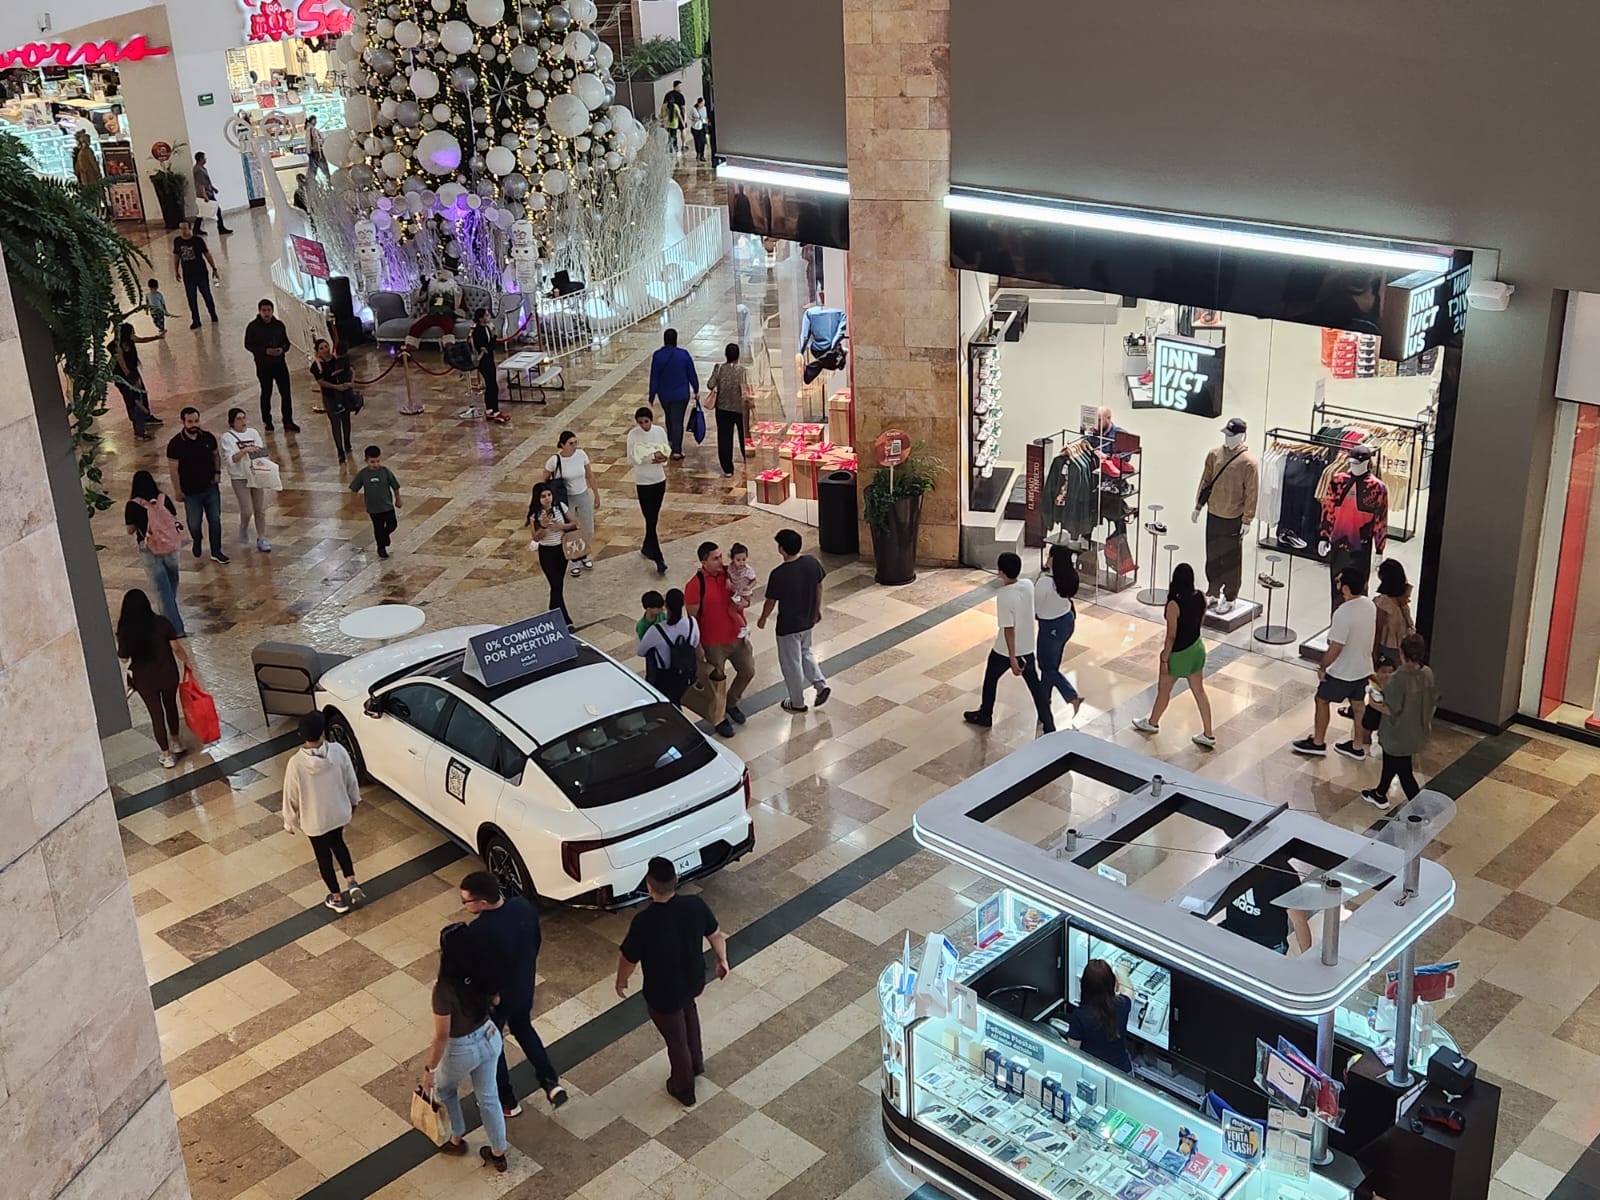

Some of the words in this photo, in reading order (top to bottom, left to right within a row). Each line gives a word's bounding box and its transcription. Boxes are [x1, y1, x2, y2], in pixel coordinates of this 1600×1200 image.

[1412, 287, 1436, 314] INN
[1410, 305, 1440, 336] VICT
[1408, 331, 1426, 356] US
[1162, 347, 1198, 372] INN
[1161, 366, 1209, 393] VICT
[1160, 386, 1188, 410] US
[484, 649, 508, 665] POR
[510, 631, 564, 657] APERTURA
[485, 639, 502, 652] 0%
[502, 621, 555, 646] COMISIÓN
[679, 860, 690, 869] K4
[1227, 1130, 1249, 1142] VENTA
[1227, 1140, 1253, 1156] FLASH
